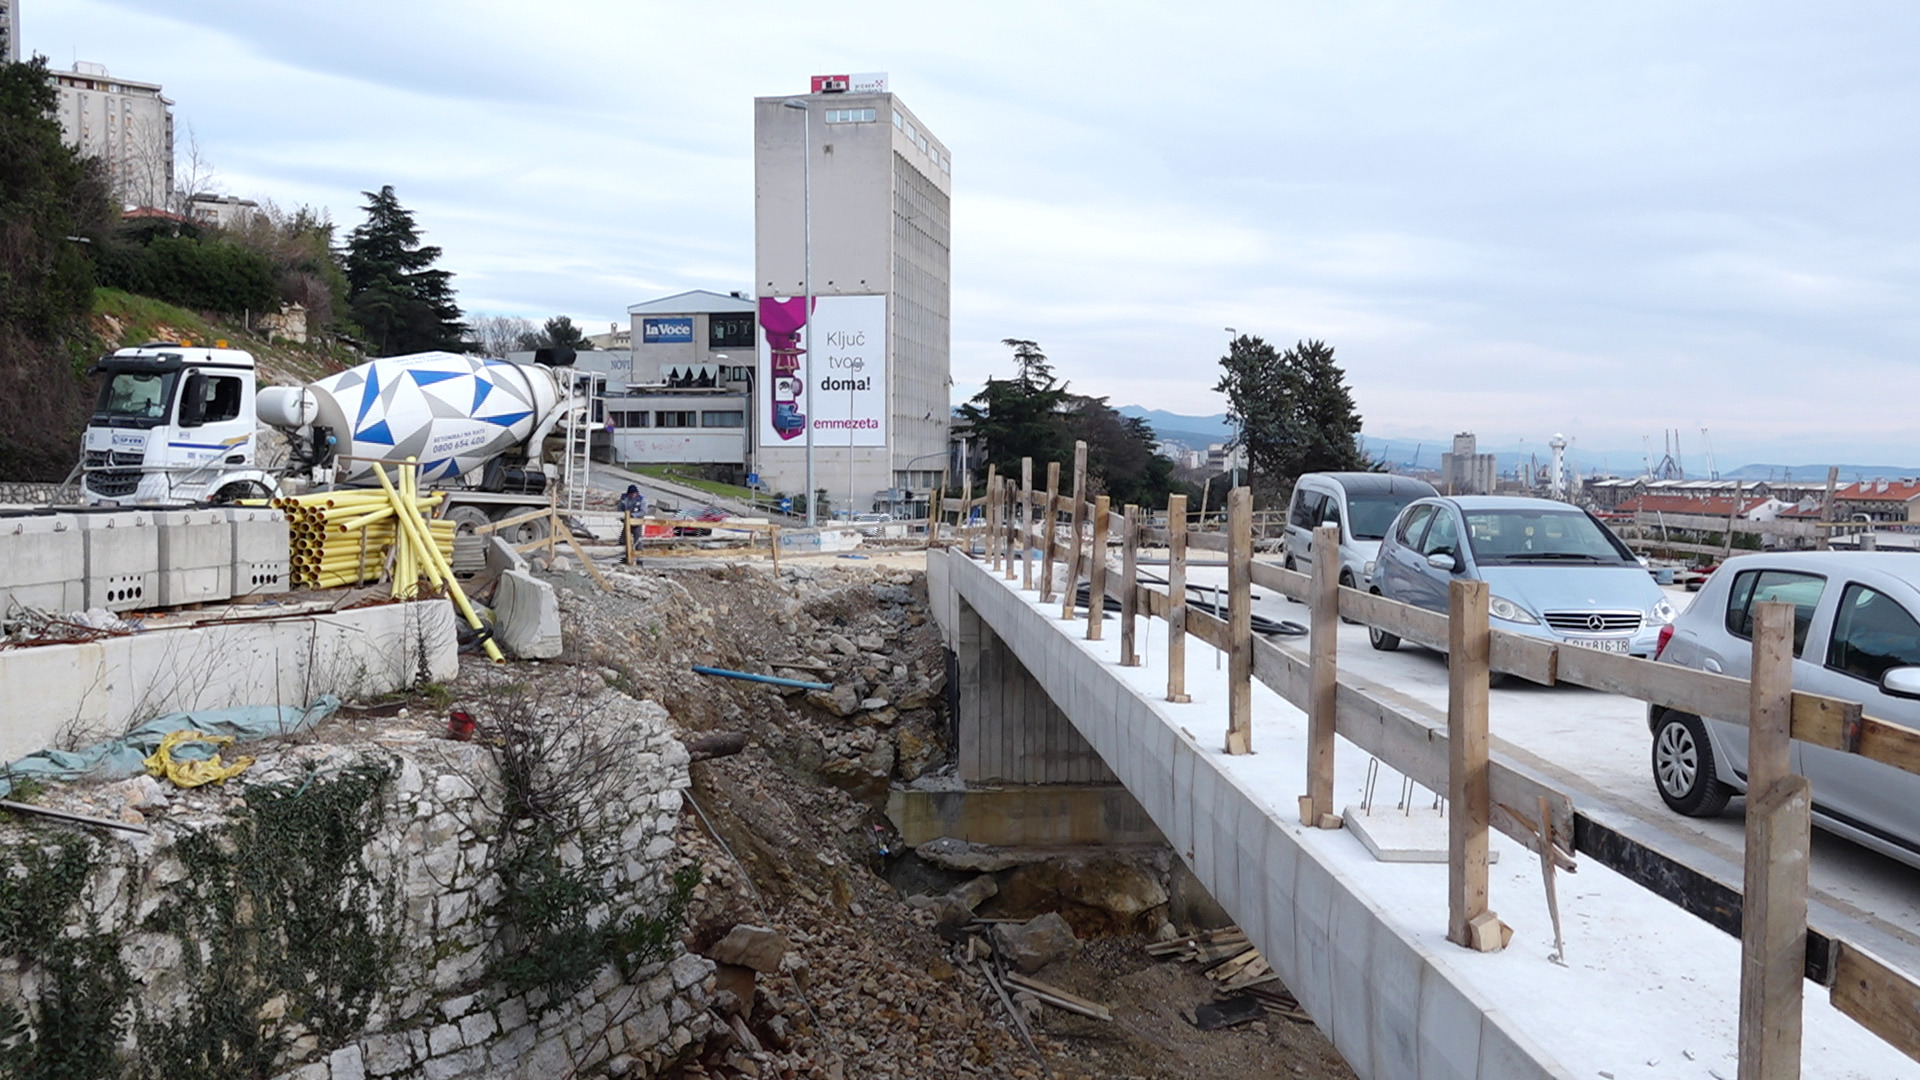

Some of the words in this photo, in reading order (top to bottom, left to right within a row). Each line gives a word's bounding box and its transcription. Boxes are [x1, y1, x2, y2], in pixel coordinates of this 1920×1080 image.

[826, 330, 865, 350] Ključ
[611, 360, 630, 370] NOVI
[828, 355, 863, 372] tvog
[821, 376, 870, 391] doma!
[813, 418, 878, 429] emmezeta
[433, 443, 453, 453] 0800
